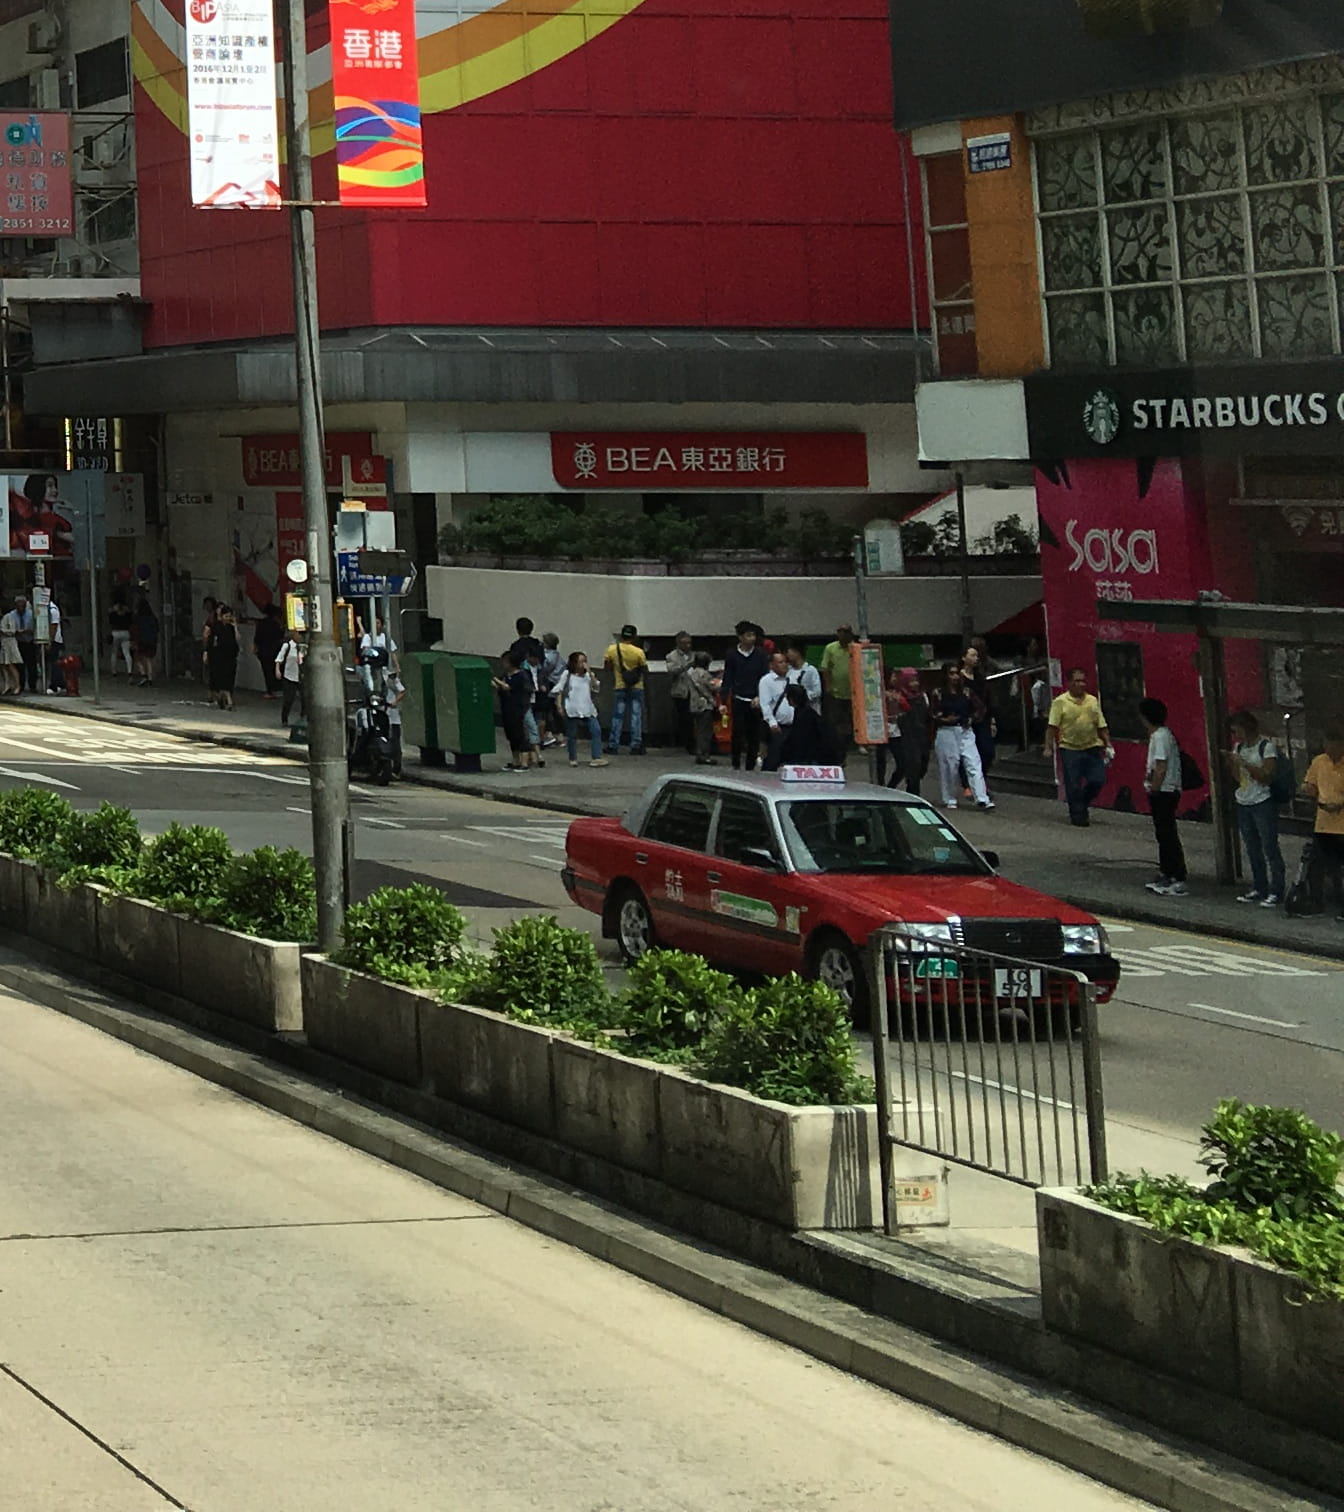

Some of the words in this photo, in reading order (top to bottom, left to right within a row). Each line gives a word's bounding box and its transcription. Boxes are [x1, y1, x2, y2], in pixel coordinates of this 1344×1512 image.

[343, 29, 402, 60] 香港
[1133, 393, 1327, 429] STARBUCKS
[262, 450, 287, 472] BEA
[606, 448, 677, 472] BEA
[681, 447, 786, 472] 東亞銀行
[793, 767, 839, 779] TAXI
